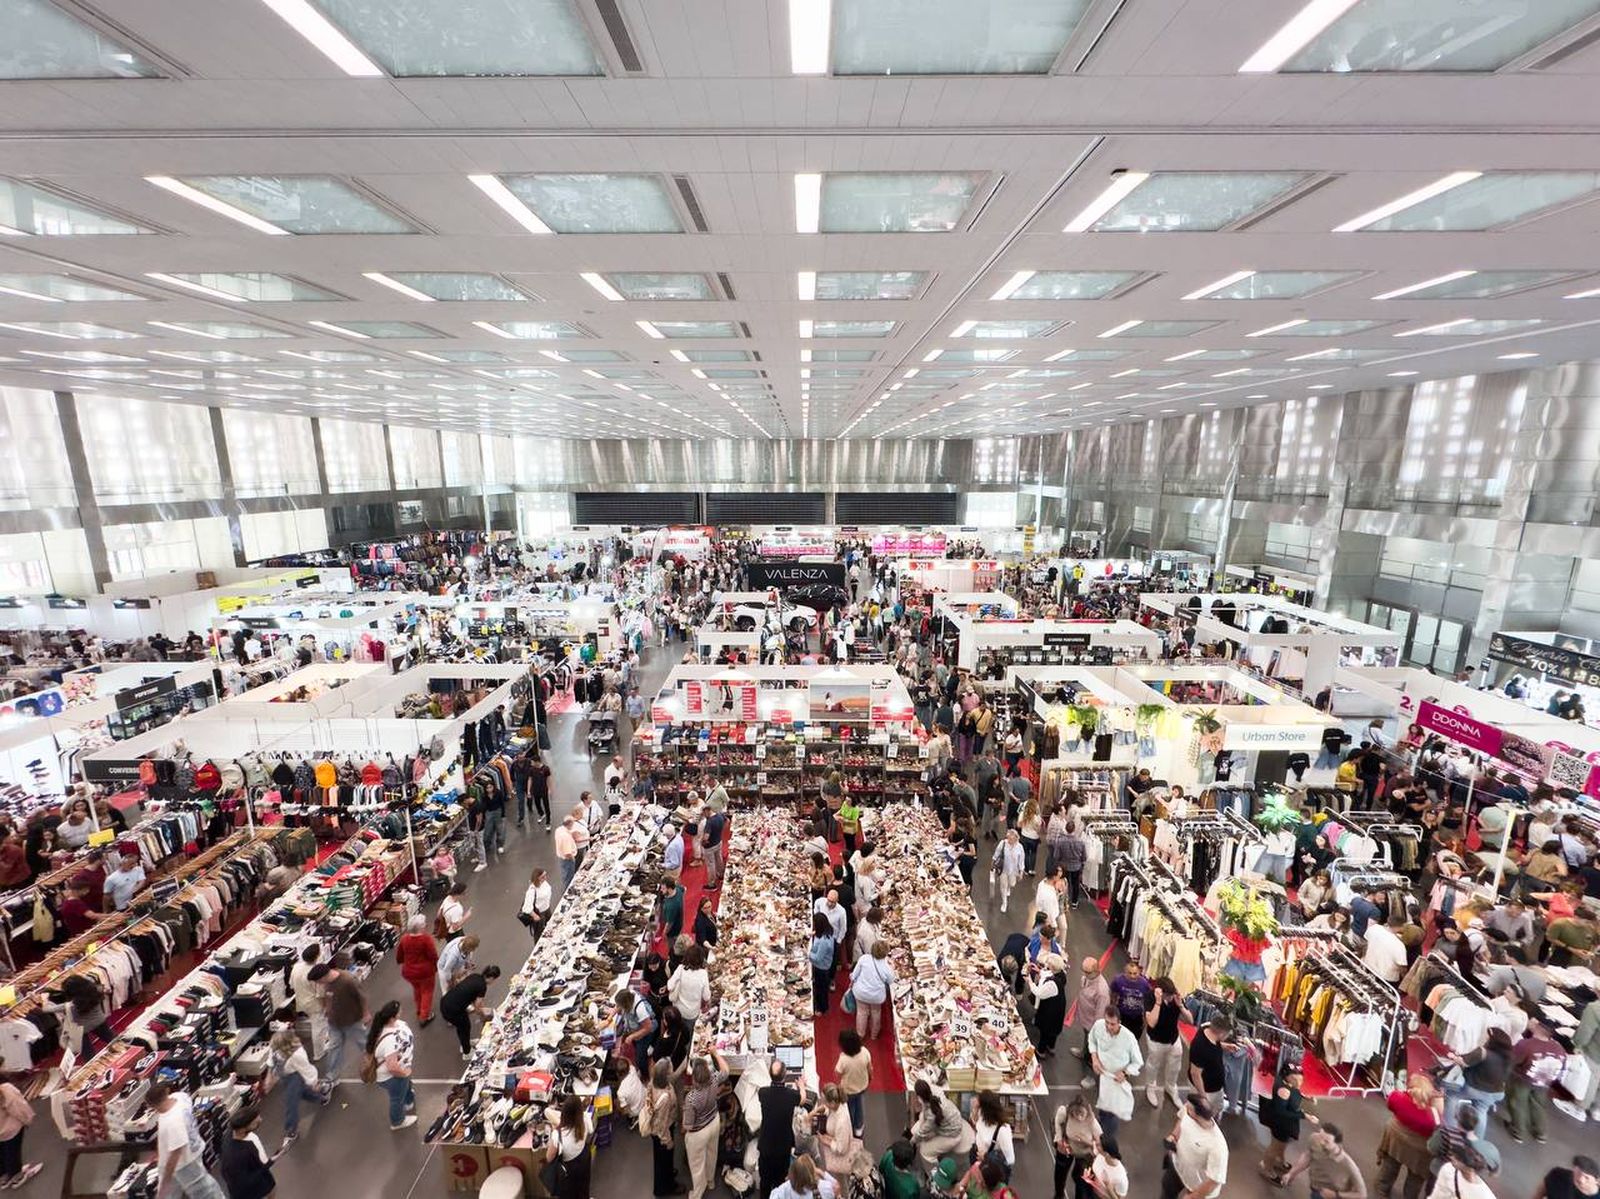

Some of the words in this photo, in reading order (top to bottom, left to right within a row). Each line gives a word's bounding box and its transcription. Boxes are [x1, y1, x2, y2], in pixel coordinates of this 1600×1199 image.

[765, 569, 828, 579] VALENZA
[1531, 659, 1559, 675] 70%
[1432, 711, 1481, 738] DDONNA
[1242, 731, 1275, 742] Urban
[1278, 731, 1306, 742] Store
[722, 1008, 734, 1018] 37
[753, 1013, 766, 1022] 38
[955, 1023, 968, 1033] 39
[992, 1019, 1005, 1029] 40
